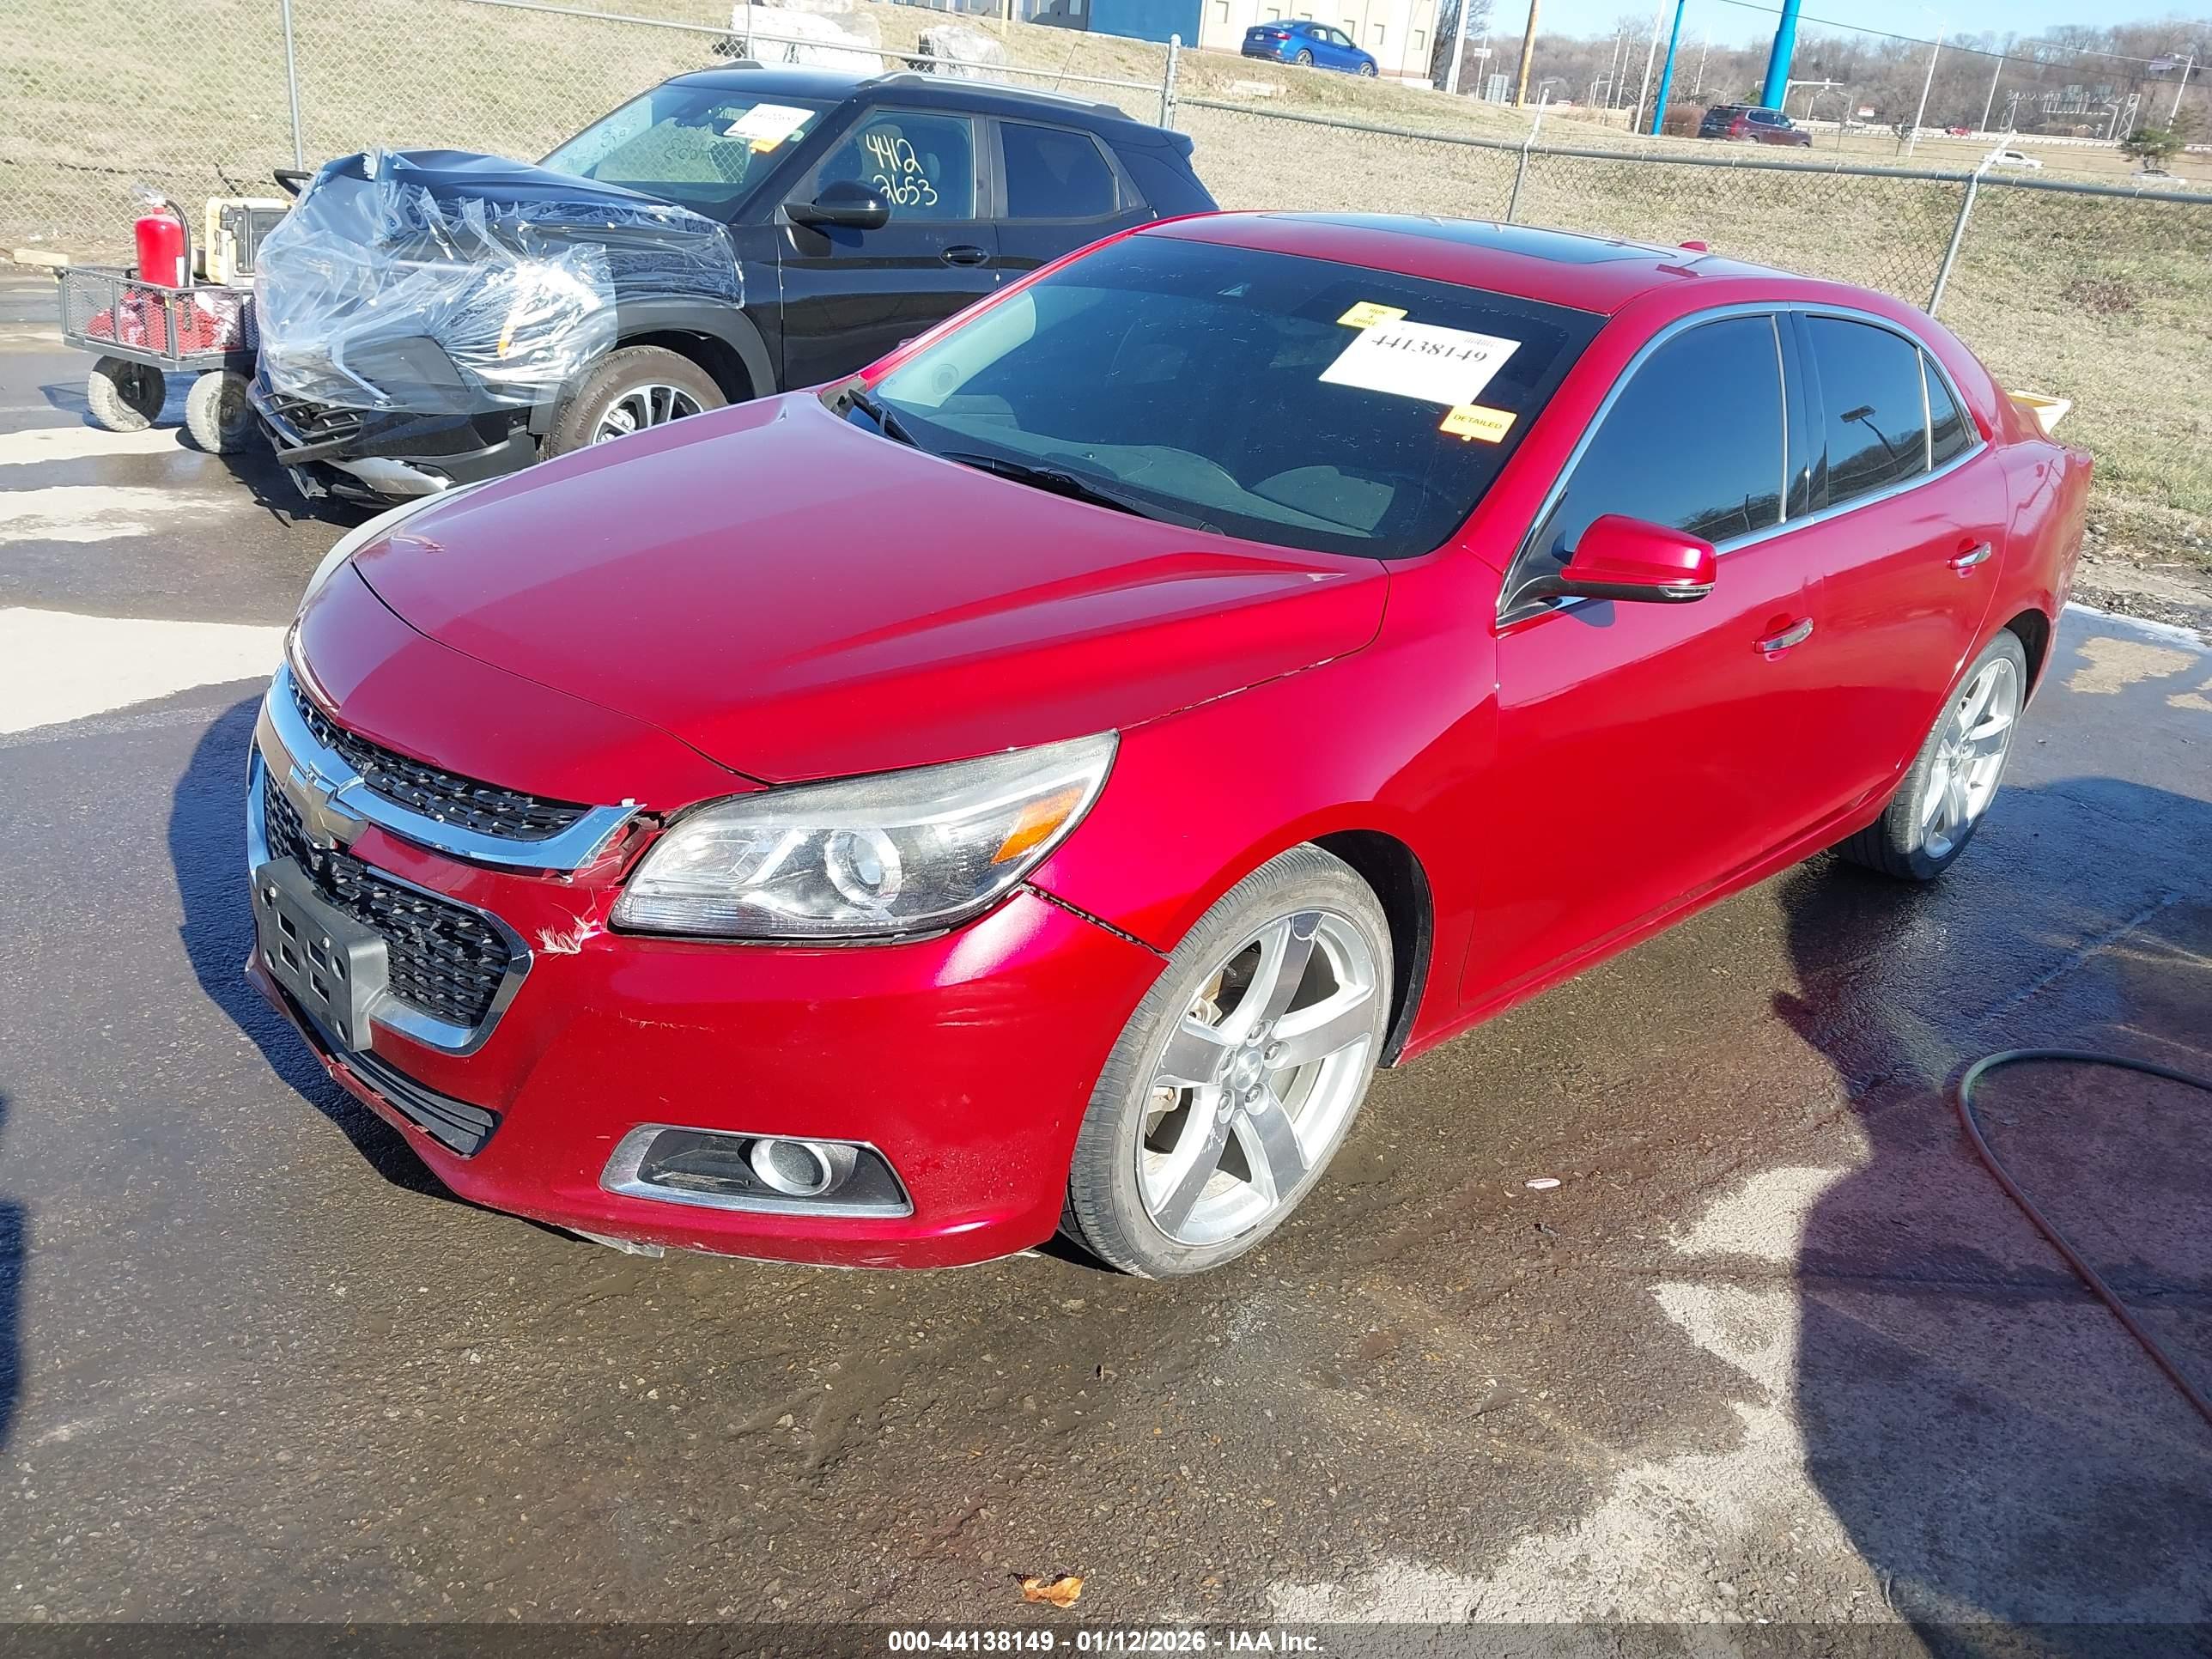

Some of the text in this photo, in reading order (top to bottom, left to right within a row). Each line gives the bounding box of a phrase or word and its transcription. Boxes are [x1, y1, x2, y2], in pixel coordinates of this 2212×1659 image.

[866, 132, 924, 174] 4412
[872, 173, 938, 205] 2653
[1371, 334, 1487, 362] 44138149
[1453, 414, 1503, 429] DETAILED
